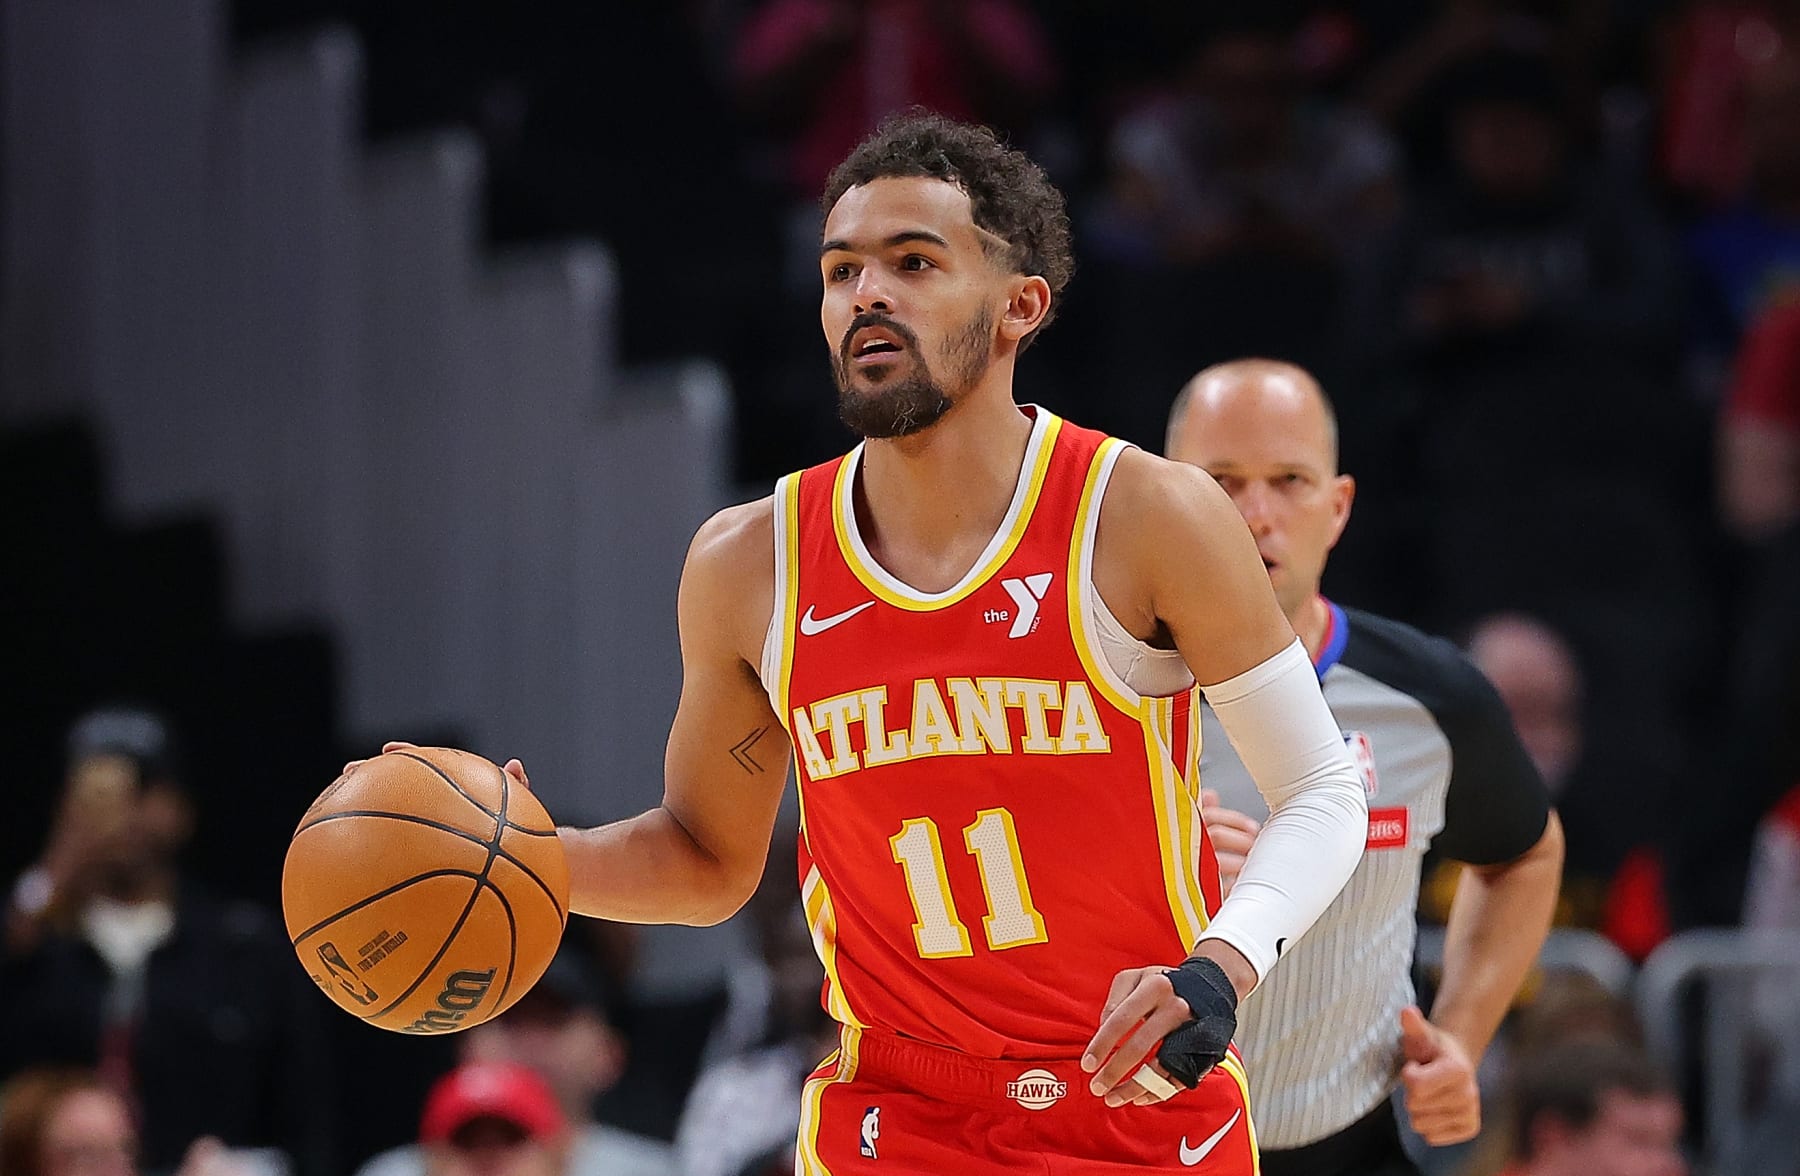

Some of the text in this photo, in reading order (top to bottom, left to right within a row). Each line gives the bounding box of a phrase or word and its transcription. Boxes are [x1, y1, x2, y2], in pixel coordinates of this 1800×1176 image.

[983, 609, 1009, 624] the
[792, 677, 1112, 782] ATLANTA
[888, 806, 1049, 959] 11
[1007, 1082, 1067, 1098] HAWKS
